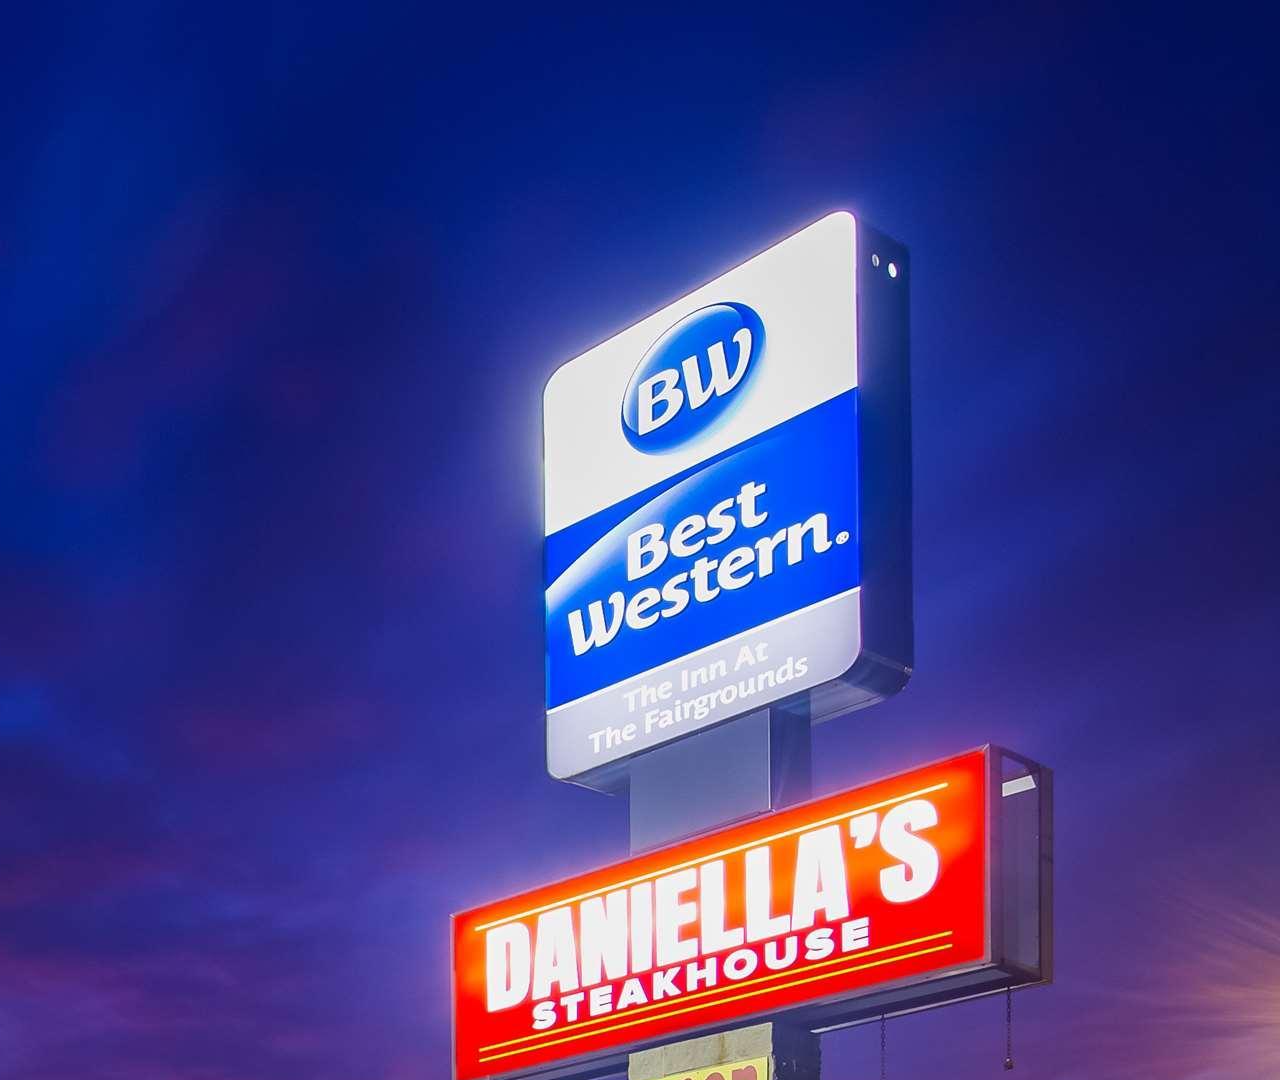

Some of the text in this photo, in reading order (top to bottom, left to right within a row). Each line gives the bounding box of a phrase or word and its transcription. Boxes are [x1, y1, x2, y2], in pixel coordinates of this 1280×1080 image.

[638, 327, 753, 436] BW
[626, 480, 768, 581] Best
[589, 656, 808, 754] The Fairgrounds
[623, 641, 768, 713] The Inn At
[486, 799, 940, 1012] DANIELLA'S
[532, 917, 871, 1031] STEAKHOUSE
